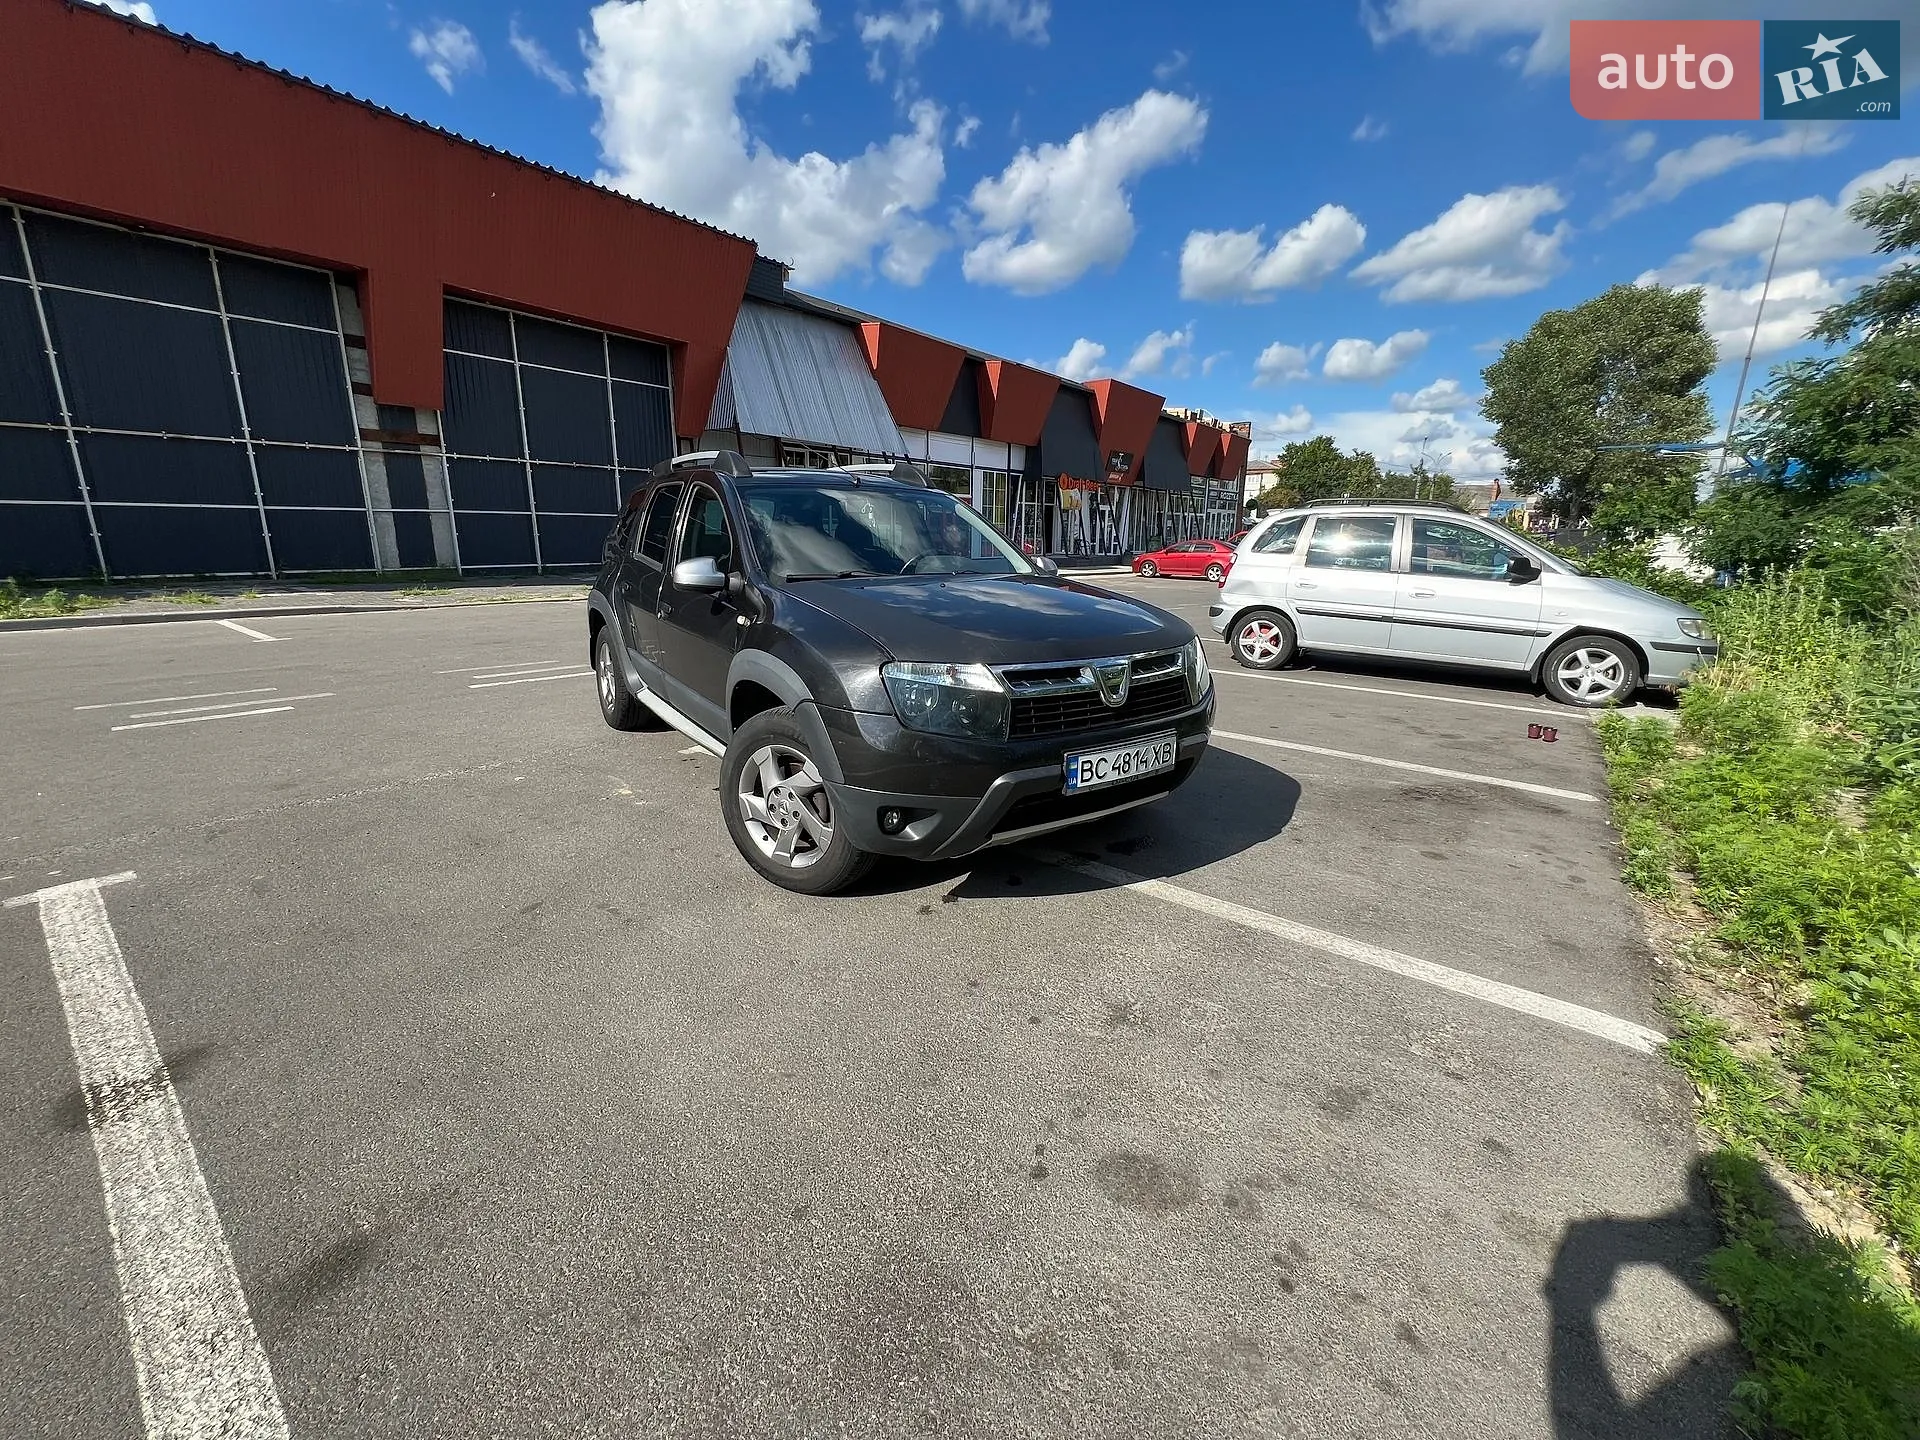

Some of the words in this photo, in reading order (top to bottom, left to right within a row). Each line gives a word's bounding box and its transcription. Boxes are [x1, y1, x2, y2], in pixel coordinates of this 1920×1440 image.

[1080, 757, 1109, 783] BC
[1111, 747, 1149, 776] 4814
[1150, 742, 1172, 768] XB
